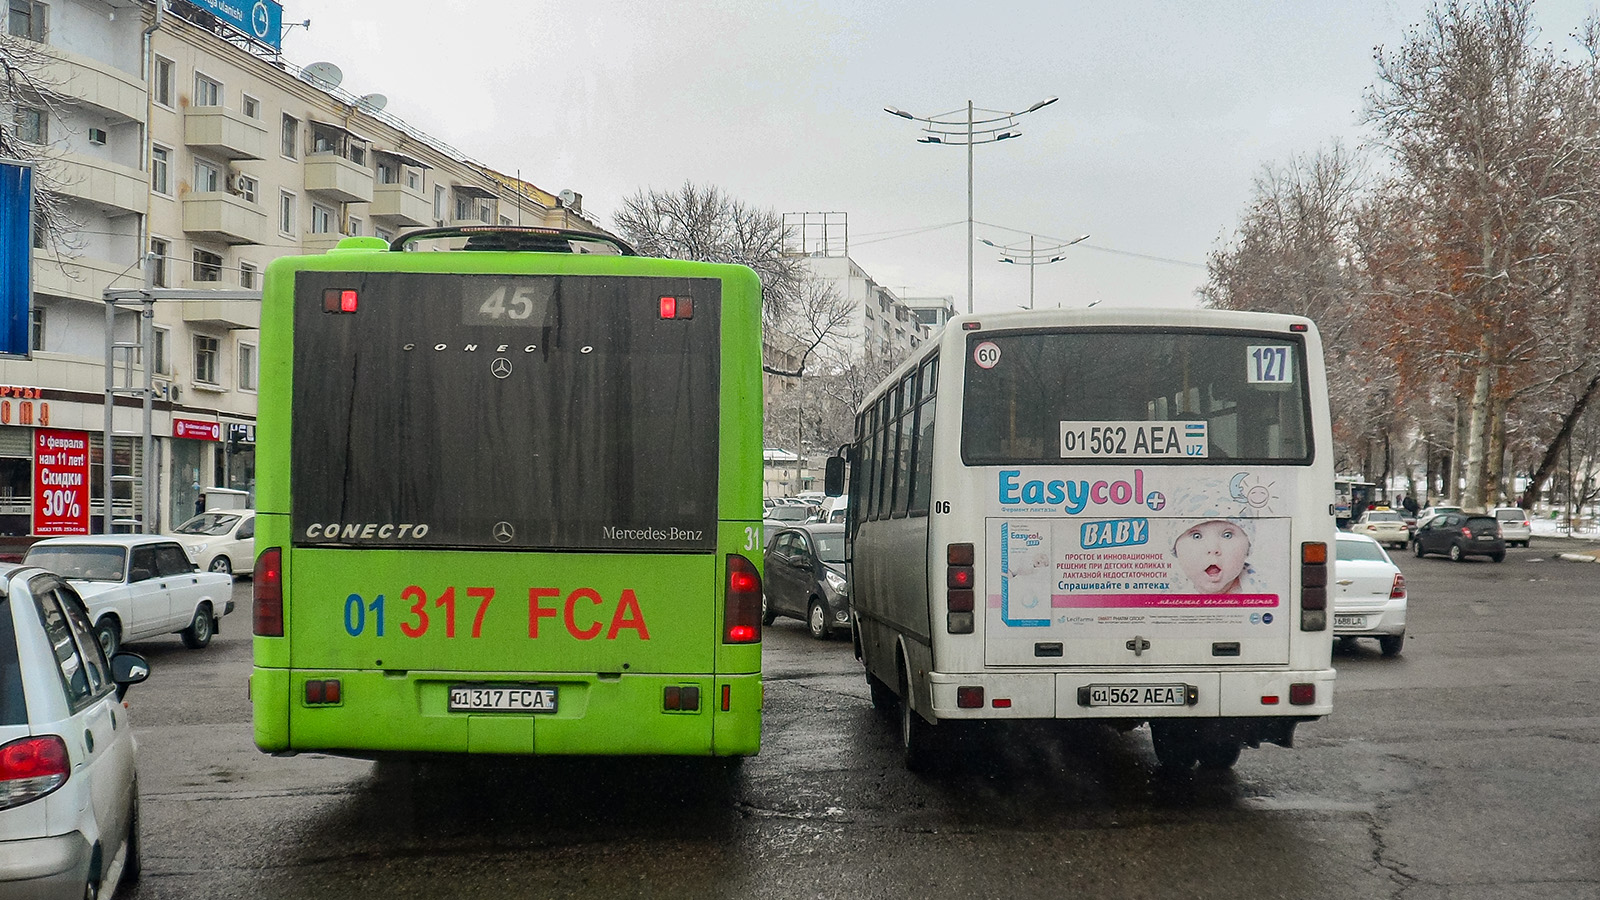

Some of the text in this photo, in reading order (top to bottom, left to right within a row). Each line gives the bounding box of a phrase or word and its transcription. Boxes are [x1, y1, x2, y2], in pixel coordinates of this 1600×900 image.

[478, 286, 534, 319] 45
[979, 349, 997, 362] 60
[1252, 347, 1286, 381] 127
[40, 434, 84, 451] 9 февраля
[1065, 426, 1182, 454] 01 562 AEA
[39, 451, 84, 466] нам 11 лет!
[1186, 445, 1204, 456] UZ
[41, 467, 82, 488] Скидки
[999, 469, 1144, 515] Easycol
[42, 489, 79, 518] 30%
[935, 501, 950, 514] 06
[306, 523, 429, 538] CONECTO
[603, 526, 702, 541] Mercedes-Benz
[743, 526, 759, 551] 31
[1084, 521, 1145, 546] BABY
[1063, 571, 1101, 579] ЛАКТАЗНОЙ
[1058, 581, 1121, 592] Спрашивайте
[344, 585, 651, 640] 01 317 FCA
[454, 692, 468, 705] 01
[472, 691, 503, 707] 317
[509, 691, 544, 707] FCA
[1110, 689, 1139, 703] 562
[1144, 689, 1175, 703] AEA
